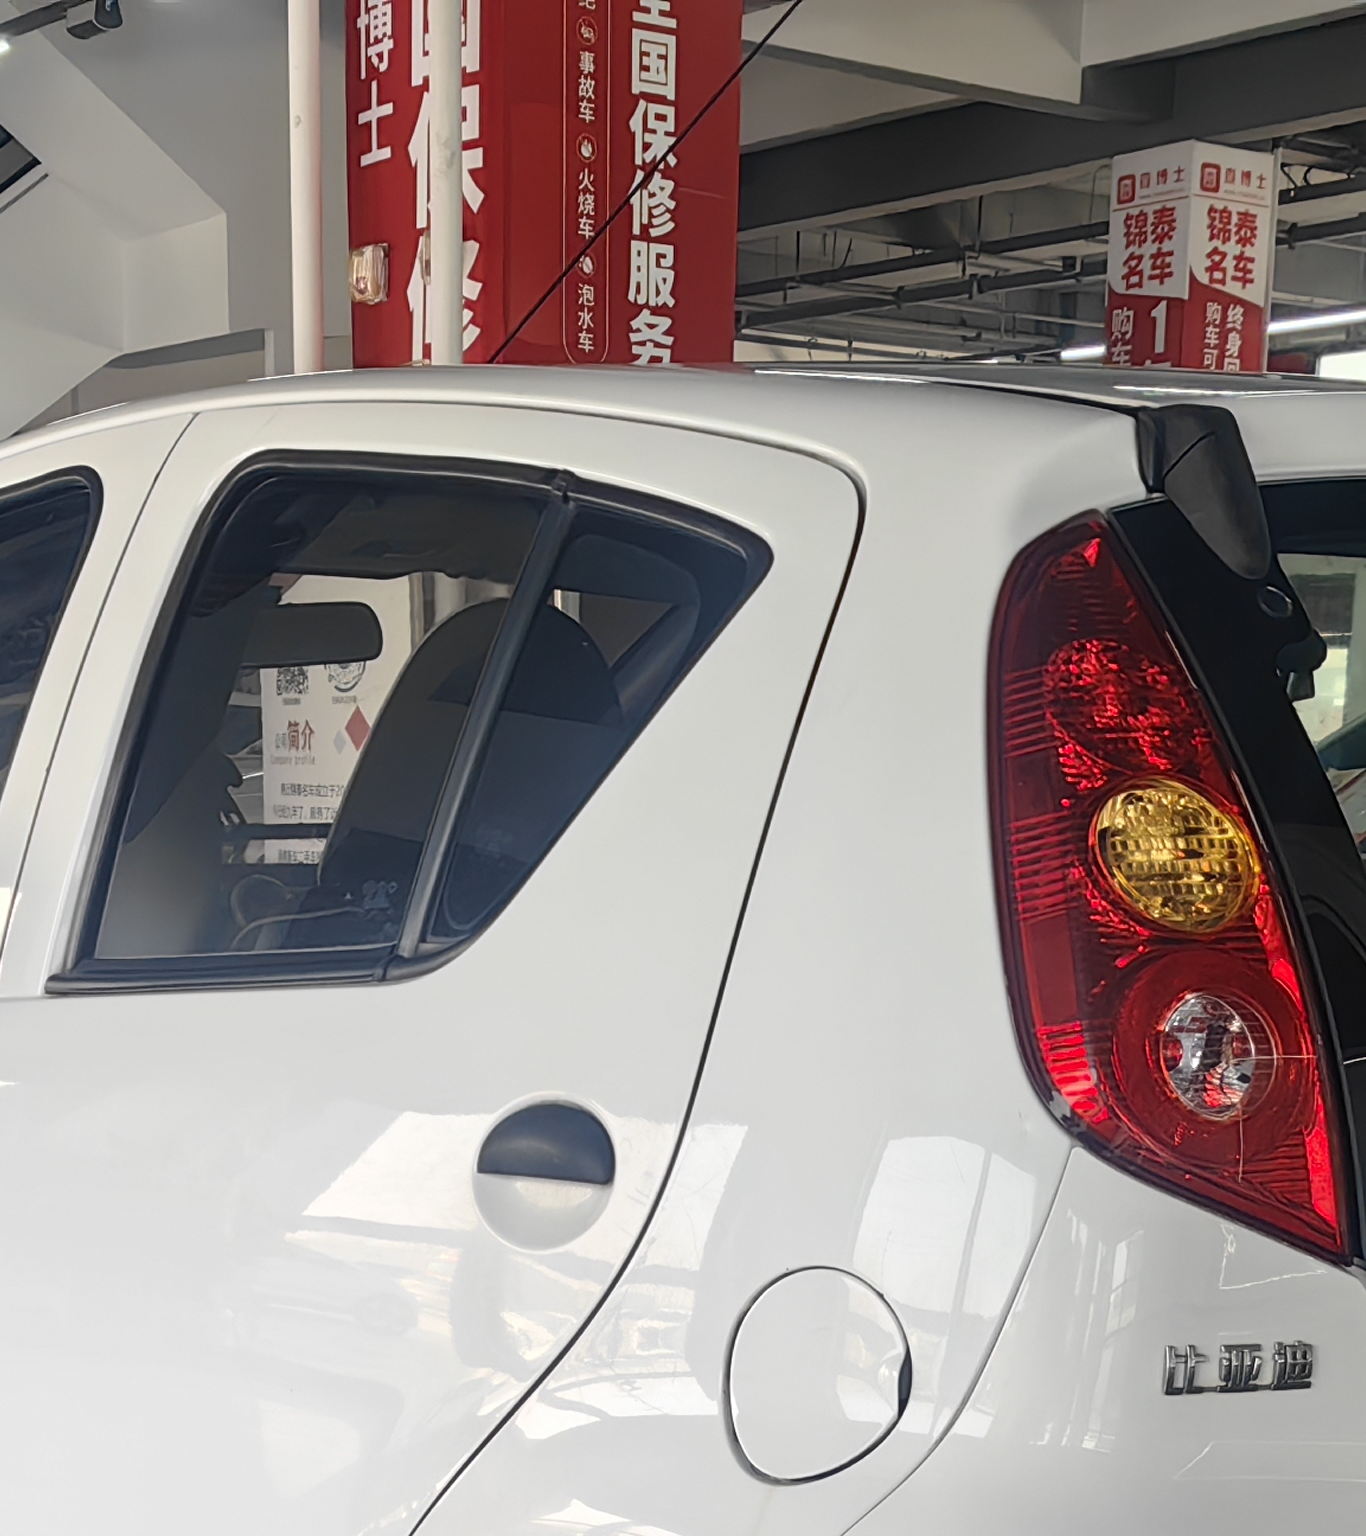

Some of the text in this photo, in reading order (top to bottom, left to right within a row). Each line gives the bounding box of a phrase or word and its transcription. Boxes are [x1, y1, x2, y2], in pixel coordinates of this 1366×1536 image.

[577, 50, 597, 353] 事故车 火烧车 泡水车
[1123, 205, 1177, 249] 锦泰
[1206, 204, 1258, 248] 锦泰
[1121, 247, 1175, 291] 名车
[1204, 246, 1256, 290] 名车
[287, 718, 315, 752] 简介
[1163, 1340, 1314, 1396] 比亚迪
